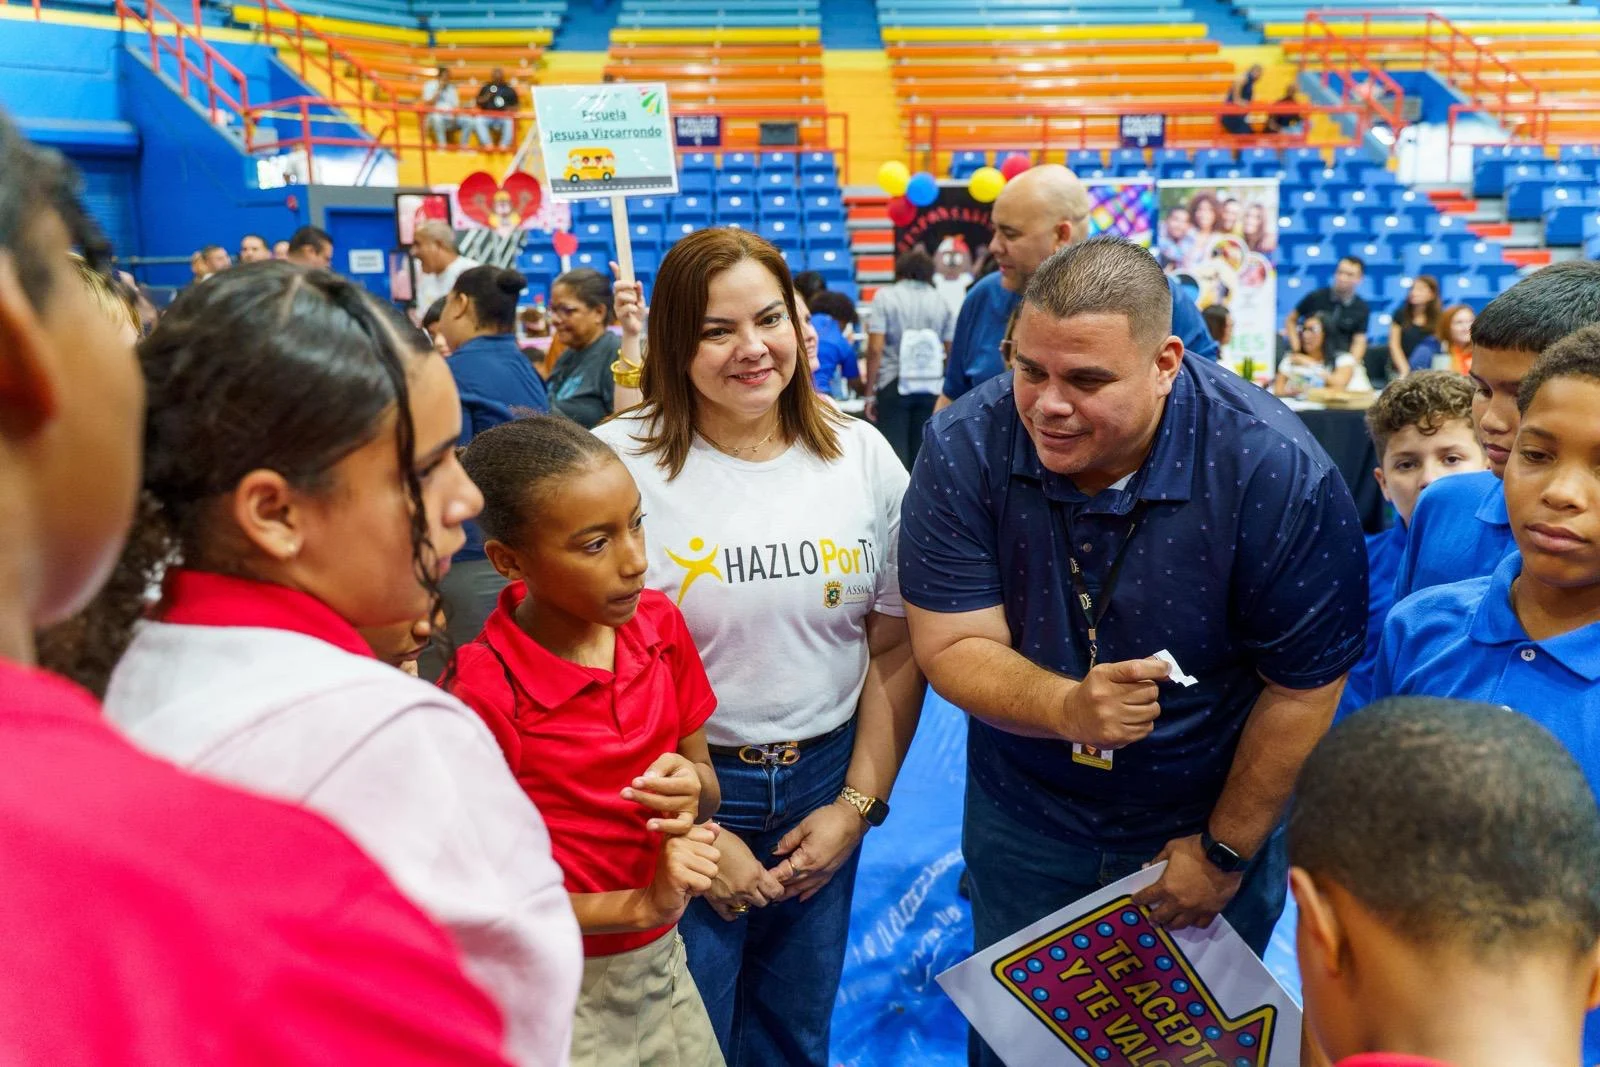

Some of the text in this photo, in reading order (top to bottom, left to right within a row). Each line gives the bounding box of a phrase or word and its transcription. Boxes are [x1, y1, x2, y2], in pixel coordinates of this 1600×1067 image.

[549, 126, 663, 142] Jesusa Vizcarrondo
[1058, 957, 1173, 1067] Y TE VAL
[1096, 938, 1229, 1067] TE ACEPT
